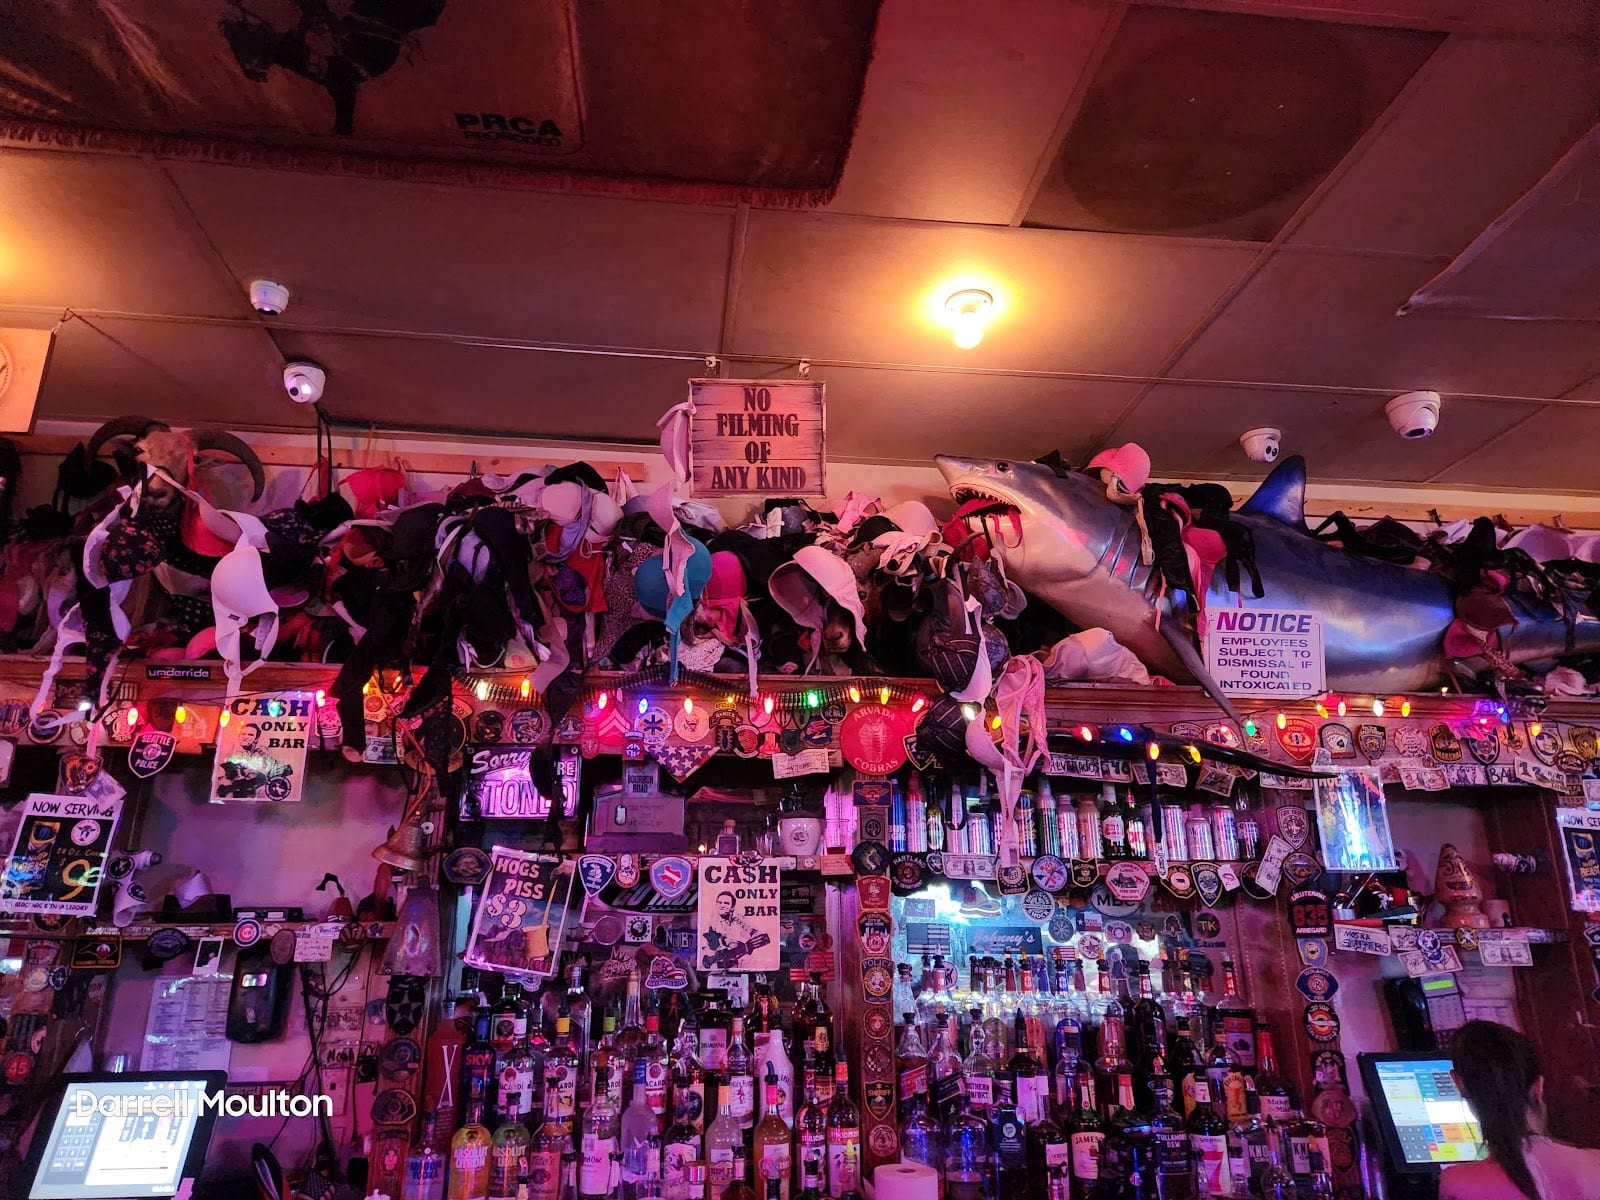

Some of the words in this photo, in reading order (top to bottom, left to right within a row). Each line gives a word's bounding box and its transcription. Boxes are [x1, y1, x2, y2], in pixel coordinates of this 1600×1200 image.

[454, 112, 563, 137] PRCA
[744, 388, 771, 411] NO
[716, 413, 800, 437] FILMING
[744, 441, 771, 464] OF
[711, 466, 749, 489] ANY
[756, 466, 807, 490] KIND
[1216, 612, 1312, 633] NOTICE
[1221, 637, 1308, 647] EMPLOYEES
[1219, 648, 1284, 658] SUBJECT
[1294, 650, 1311, 658] TO
[1217, 659, 1294, 669] DISMISSAL
[1301, 661, 1312, 669] IF
[149, 668, 209, 678] underride
[1240, 670, 1290, 679] FOUND
[1219, 680, 1312, 690] INTOXICATED
[853, 705, 895, 721] ARVADA
[261, 721, 307, 732] ONLY
[142, 735, 172, 746] SEATTLE
[268, 738, 305, 748] BAR
[135, 759, 159, 770] POLICE
[854, 757, 898, 773] COBRAS
[632, 784, 648, 793] ROAD
[32, 802, 61, 814] NOW
[64, 803, 114, 817] SERVIG
[893, 855, 927, 868] HARTLAND
[496, 857, 540, 879] HOGS
[504, 879, 544, 900] PISS
[735, 889, 778, 899] ONLY
[744, 906, 778, 916] BAR
[1293, 904, 1328, 926] 835
[1200, 921, 1217, 931] TK
[863, 959, 893, 969] POLICE
[466, 1053, 494, 1066] SKYY
[8, 1062, 28, 1075] 45
[1248, 1145, 1269, 1157] KNO
